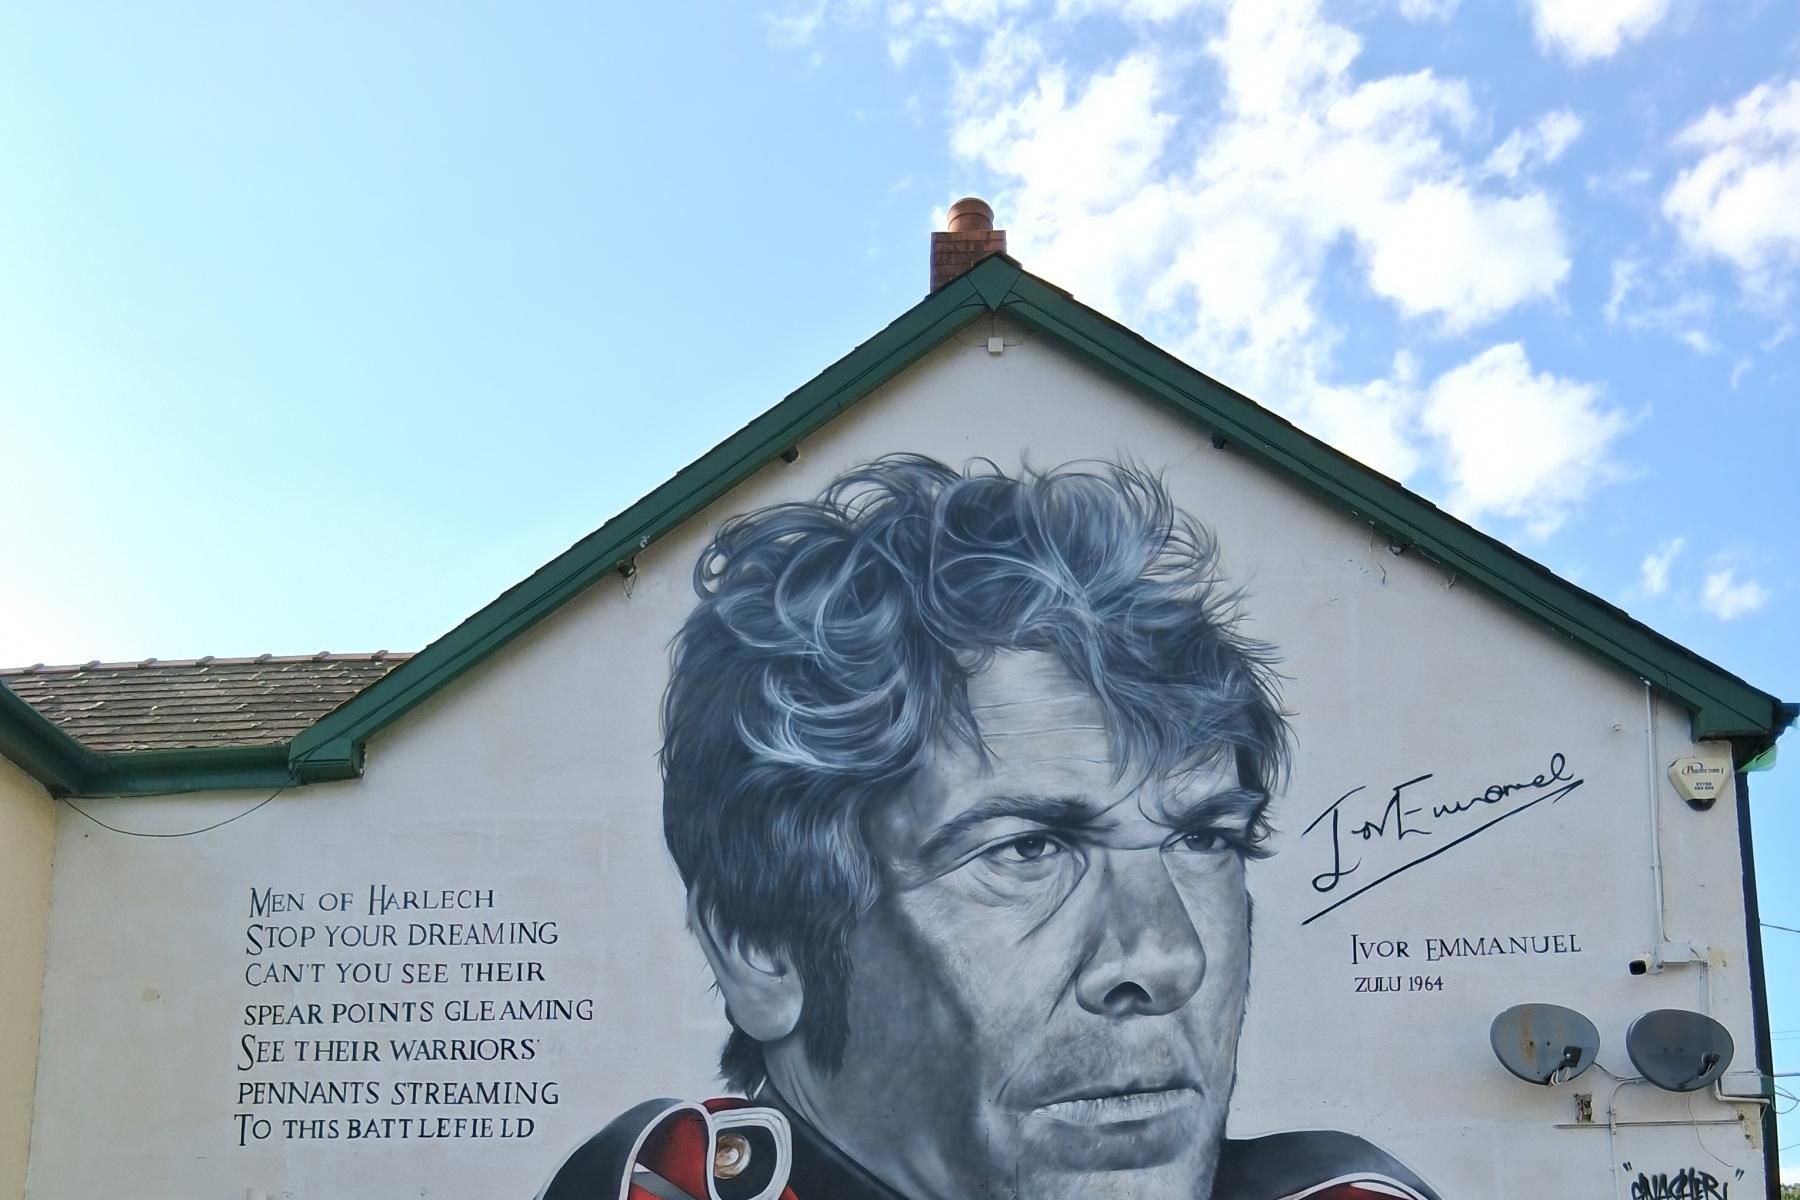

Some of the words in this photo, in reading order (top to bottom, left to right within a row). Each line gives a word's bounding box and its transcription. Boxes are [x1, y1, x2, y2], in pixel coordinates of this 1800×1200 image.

[249, 888, 304, 918] MEN
[319, 893, 353, 911] OF
[368, 884, 494, 915] HARLECH
[246, 924, 315, 955] STOP
[325, 925, 397, 947] YOUR
[408, 922, 558, 945] DREAMING
[1351, 934, 1410, 964] IVOR
[1425, 934, 1581, 961] EMMANUEL
[246, 963, 325, 987] CAN'T
[336, 963, 392, 983] YOU
[402, 963, 448, 984] SEE
[461, 962, 545, 982] THEIR
[1355, 976, 1402, 992] ZULU
[1408, 976, 1443, 991] 1964
[244, 1004, 324, 1025] SPEAR
[332, 1001, 434, 1023] POINTS
[445, 999, 593, 1021] GLEAMING
[238, 1034, 284, 1071] SEE
[295, 1040, 381, 1061] THEIR
[237, 1081, 379, 1104] PENNANTS
[391, 1082, 558, 1105] STREAMING
[234, 1114, 271, 1146] TO
[283, 1120, 339, 1139] THIS
